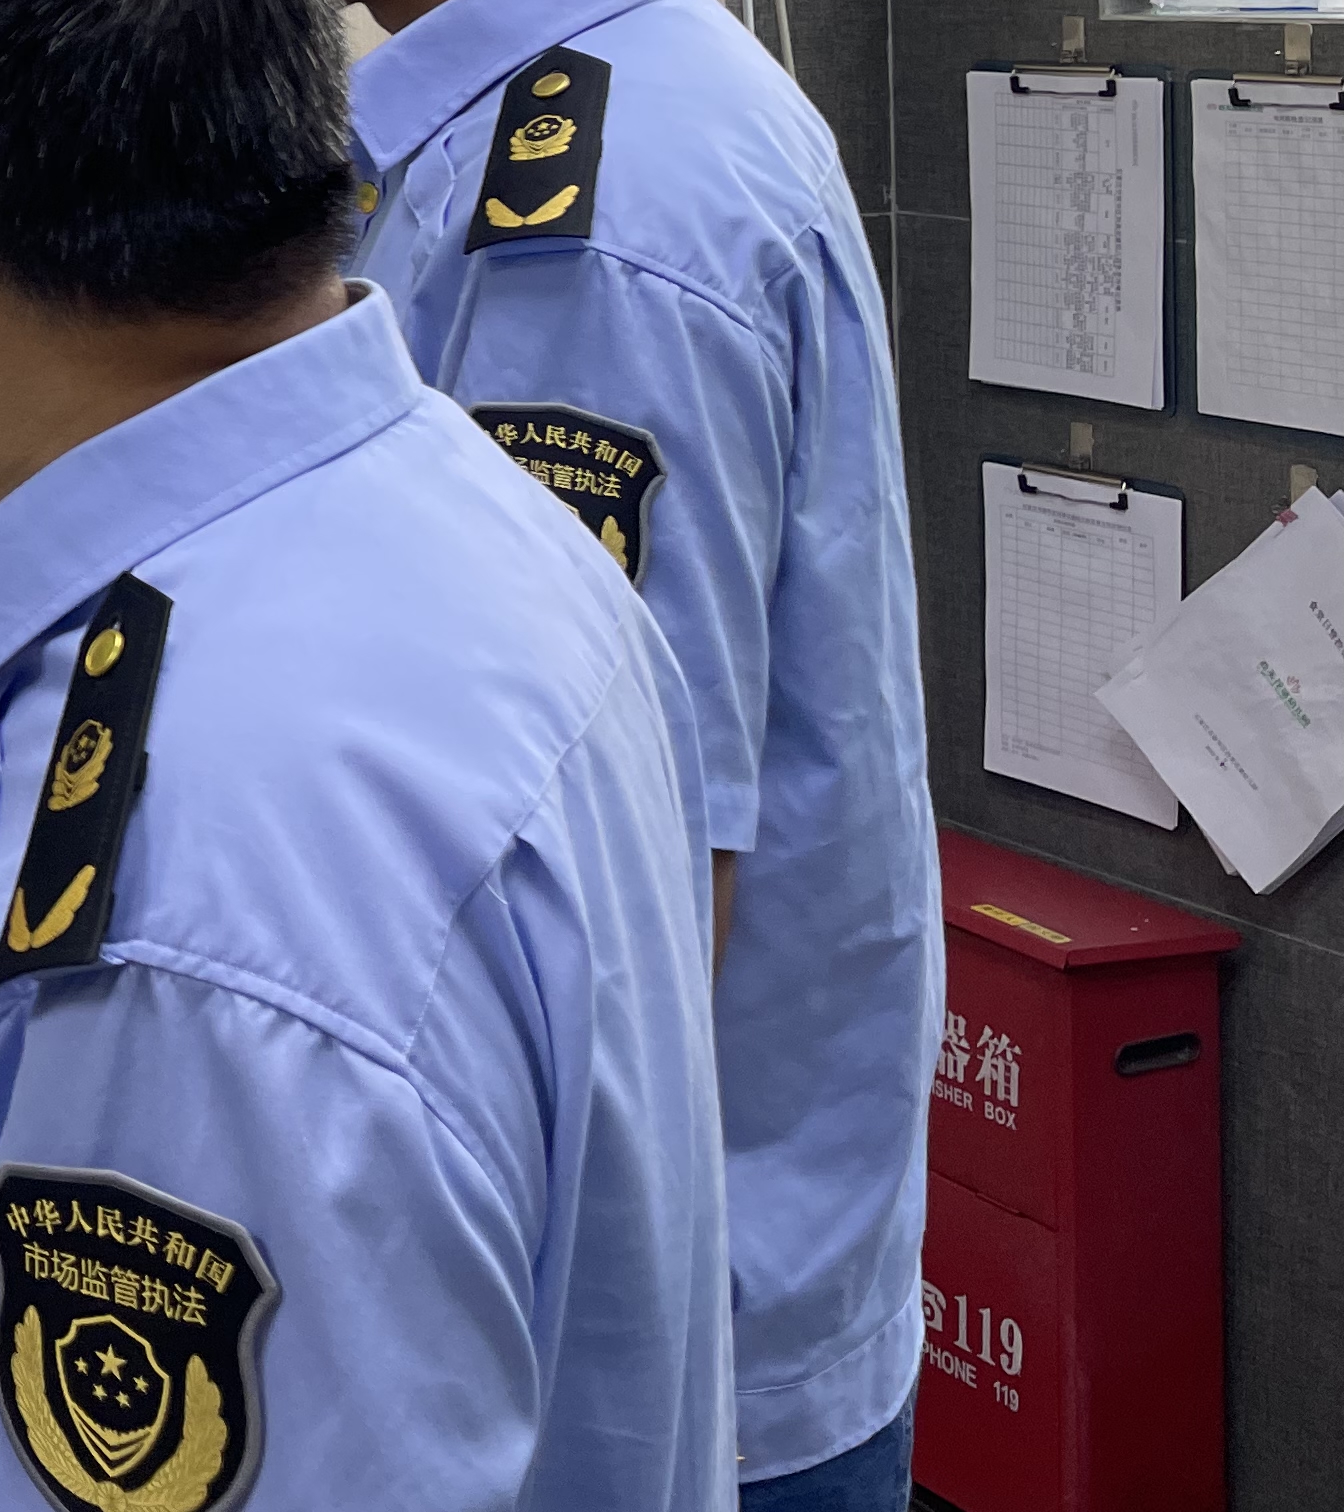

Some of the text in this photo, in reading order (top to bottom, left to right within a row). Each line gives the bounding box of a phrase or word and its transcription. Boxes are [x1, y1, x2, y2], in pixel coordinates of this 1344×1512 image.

[485, 422, 644, 478] 华人民共和国
[984, 1101, 1017, 1131] BOX
[6, 1199, 237, 1294] 中华人民共和国
[23, 1241, 208, 1326] 市场监管执法
[994, 1381, 1019, 1413] 119
